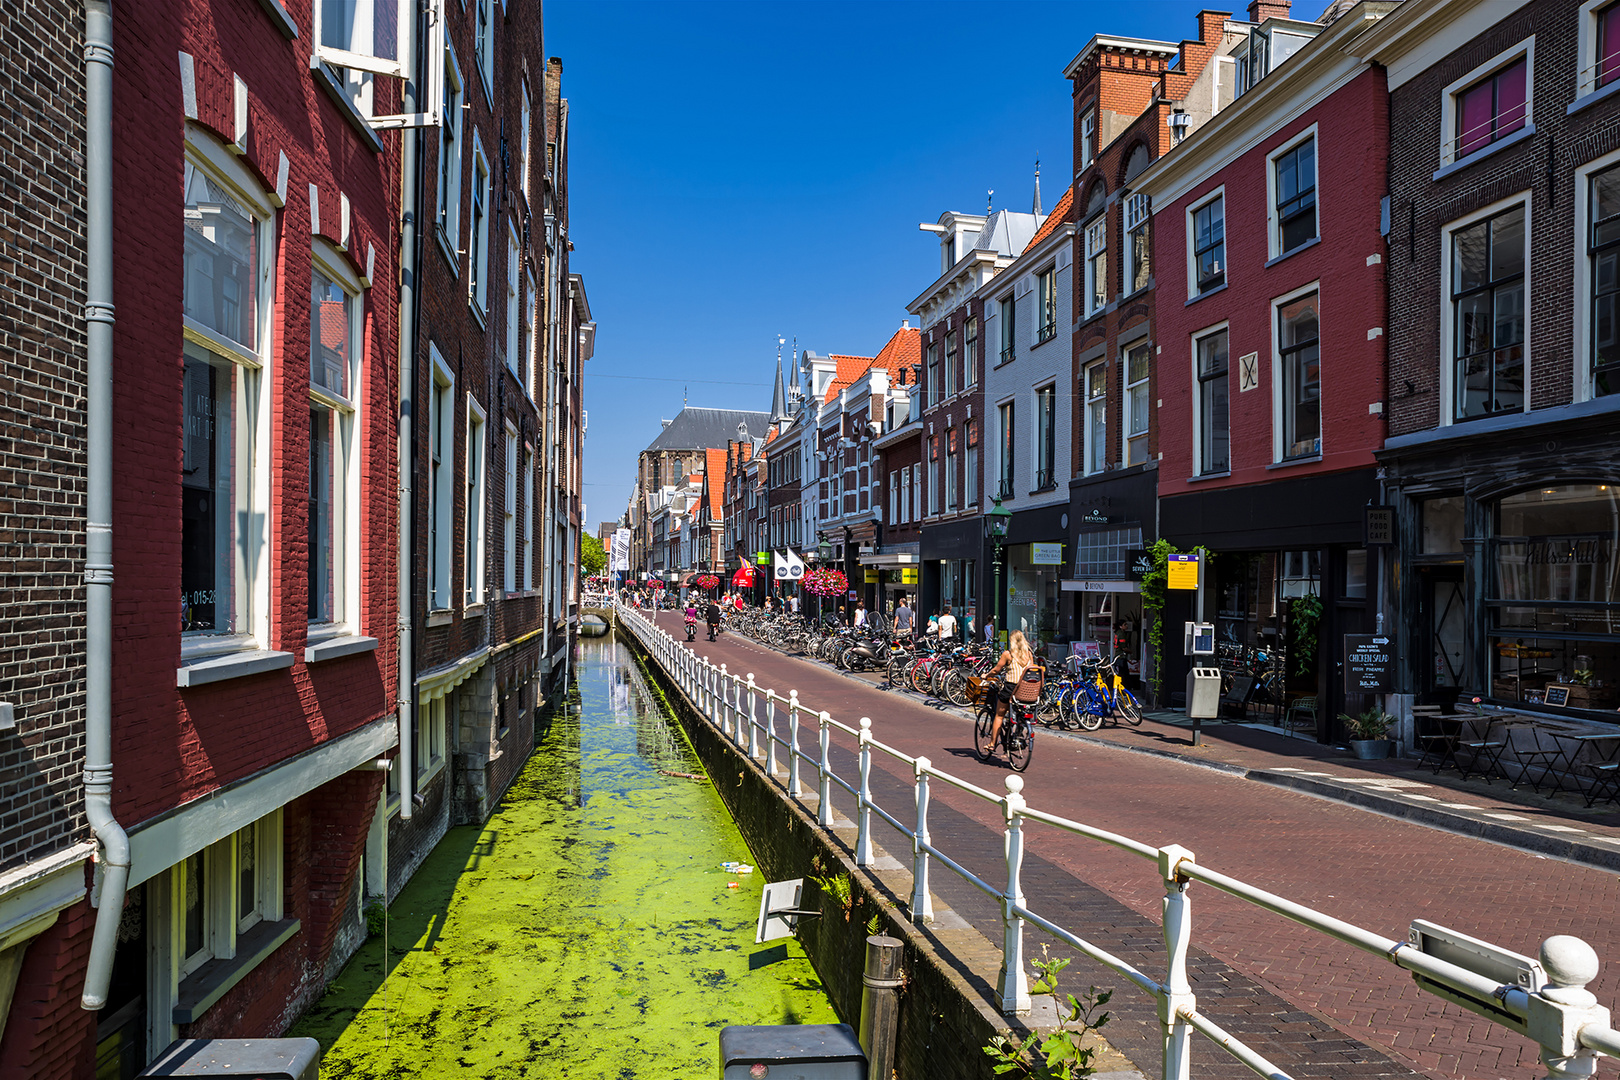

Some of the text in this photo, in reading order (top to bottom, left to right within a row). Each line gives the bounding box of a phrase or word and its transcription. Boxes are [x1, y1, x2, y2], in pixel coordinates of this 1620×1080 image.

[187, 415, 214, 441] ART OF
[1370, 512, 1387, 520] PURE
[1370, 522, 1387, 530] FOOD
[1089, 582, 1105, 590] BEYOND
[1010, 597, 1037, 607] GREEN BAG
[1348, 654, 1390, 663] CHICKEN SALAD
